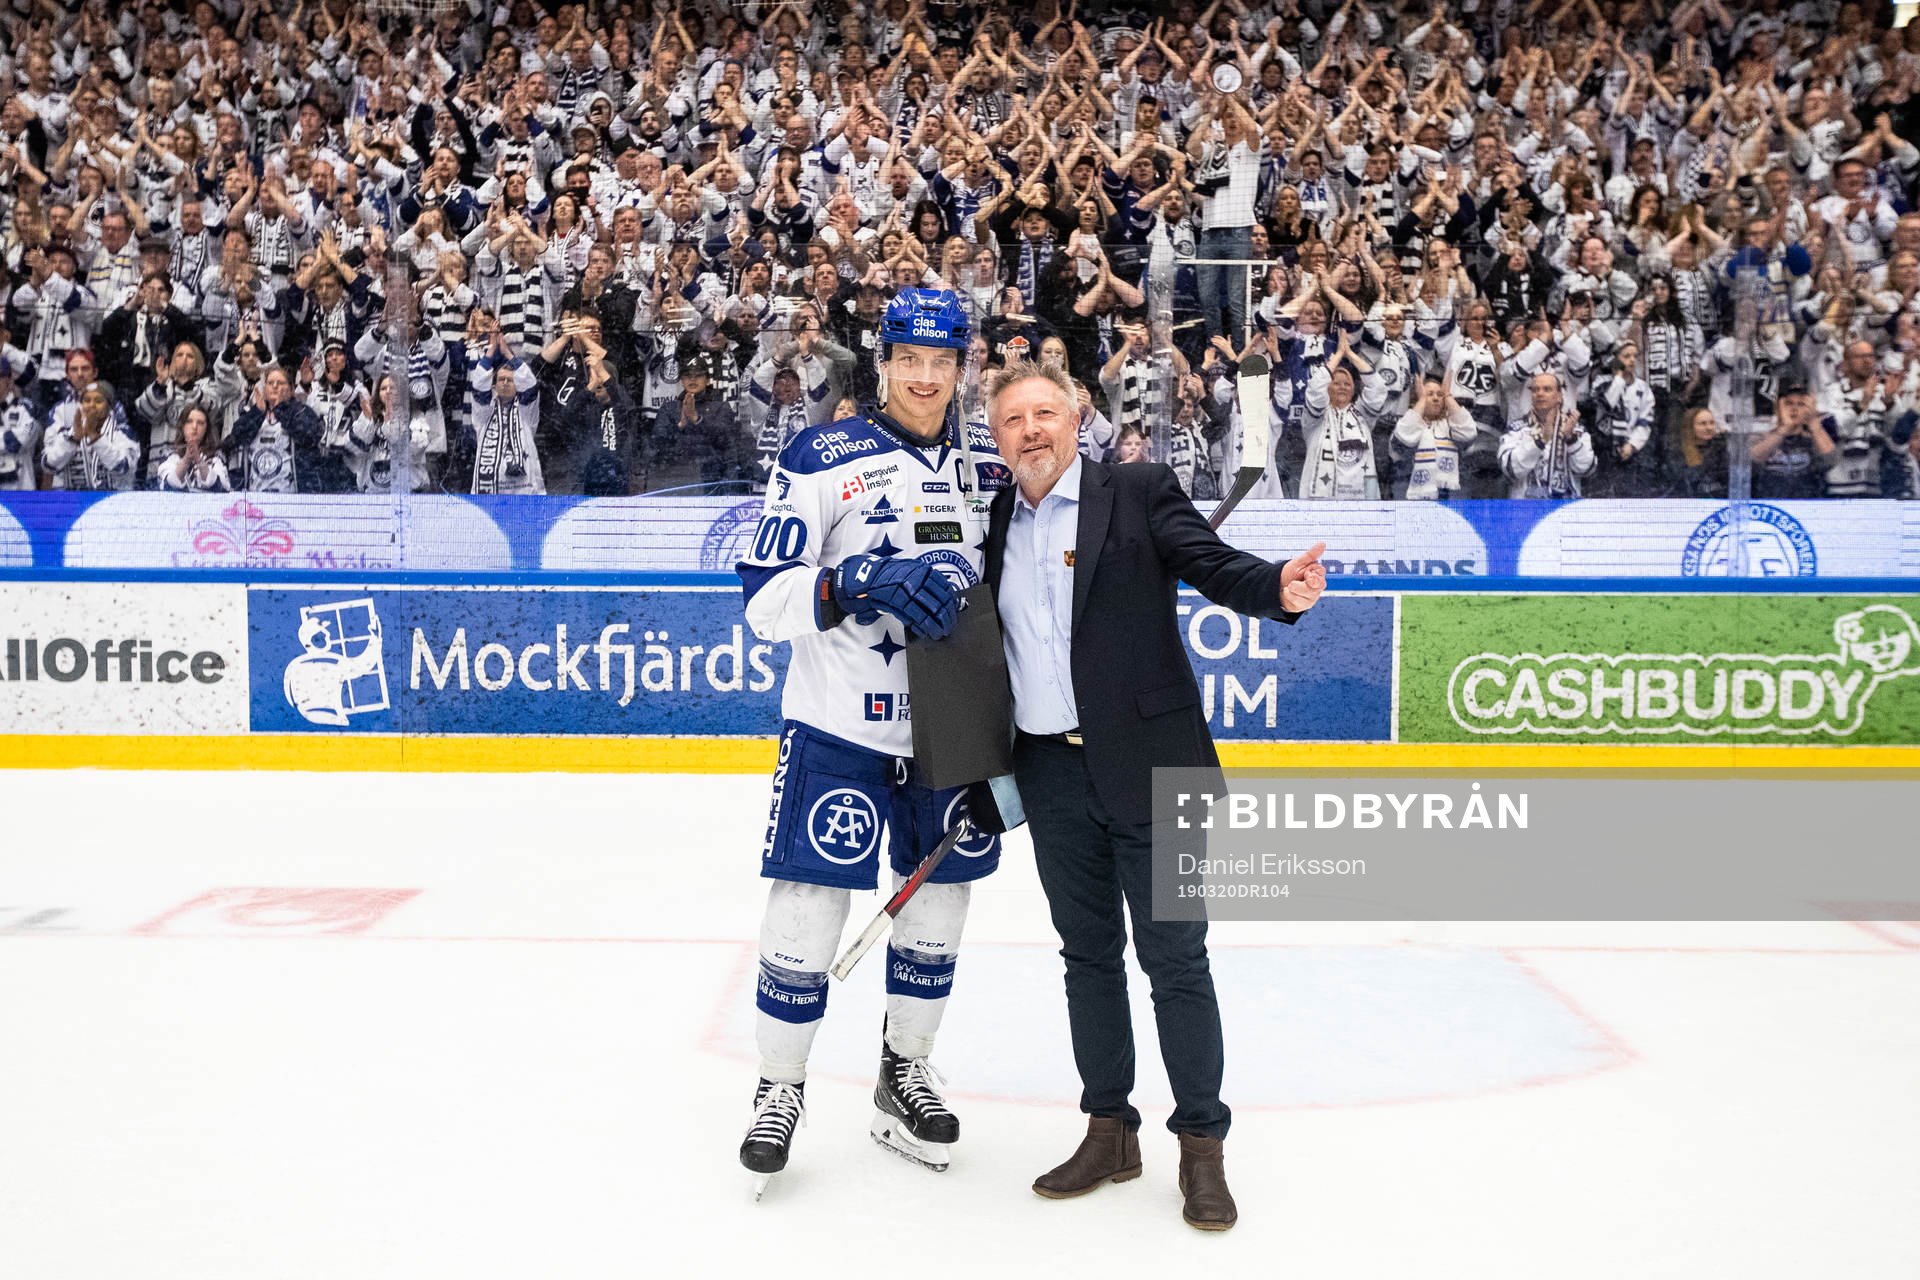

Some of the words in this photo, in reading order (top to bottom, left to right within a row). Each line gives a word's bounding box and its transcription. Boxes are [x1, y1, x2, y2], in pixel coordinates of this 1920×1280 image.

[913, 316, 936, 328] clas
[912, 327, 948, 338] ohlson
[812, 431, 849, 450] clas
[873, 423, 903, 446] TEGERA
[821, 439, 878, 464] ohlson
[924, 505, 955, 513] TEGERA
[0, 637, 226, 684] llOffice
[410, 624, 776, 708] Mockfjärds
[1463, 667, 1864, 720] CASHBUDDY
[916, 940, 946, 948] CCM
[774, 952, 805, 964] CCM
[768, 988, 791, 1003] KARL
[791, 995, 819, 1005] HEDIN
